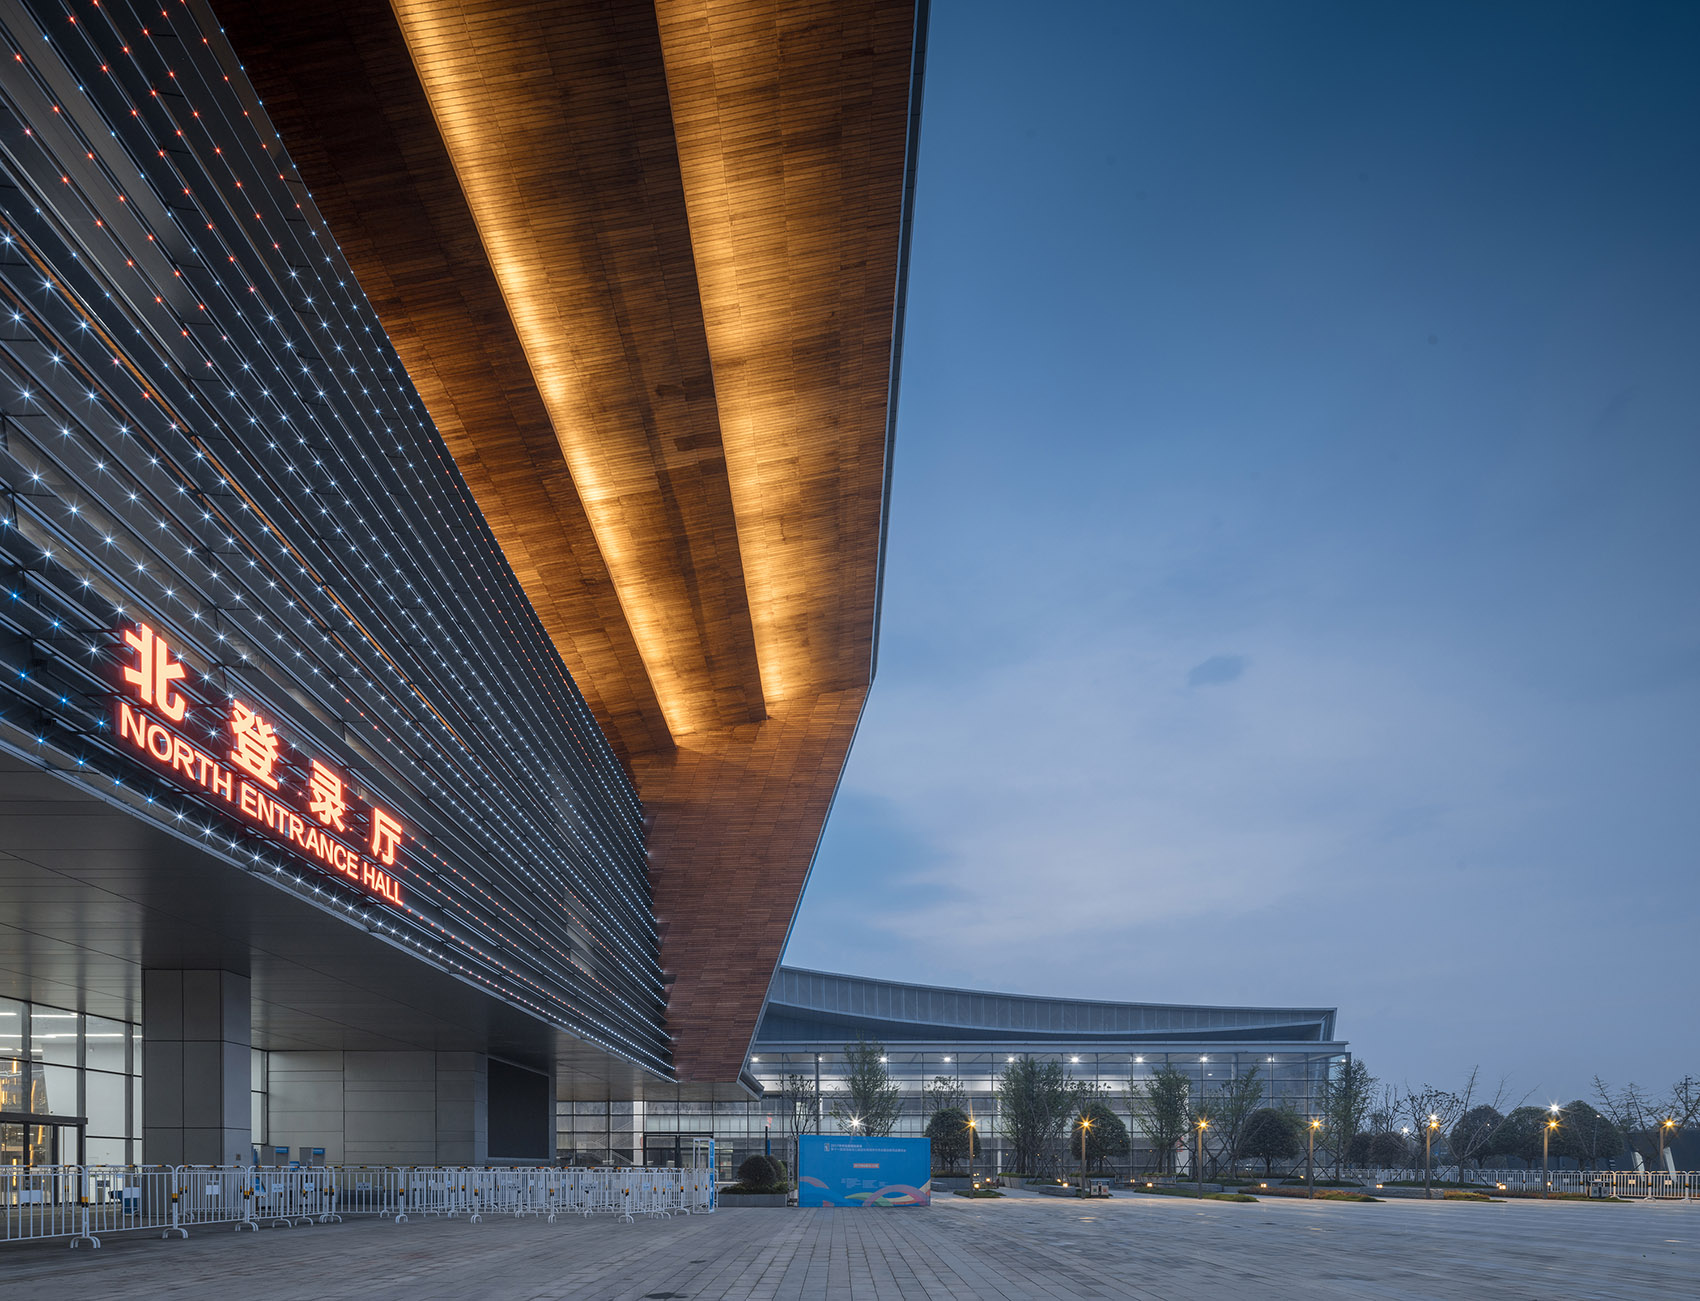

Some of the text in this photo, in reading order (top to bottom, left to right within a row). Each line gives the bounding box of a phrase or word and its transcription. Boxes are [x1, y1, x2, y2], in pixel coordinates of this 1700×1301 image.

[119, 702, 404, 907] NORTH ENTRANCE HALL
[123, 622, 404, 866] 北登录厅
